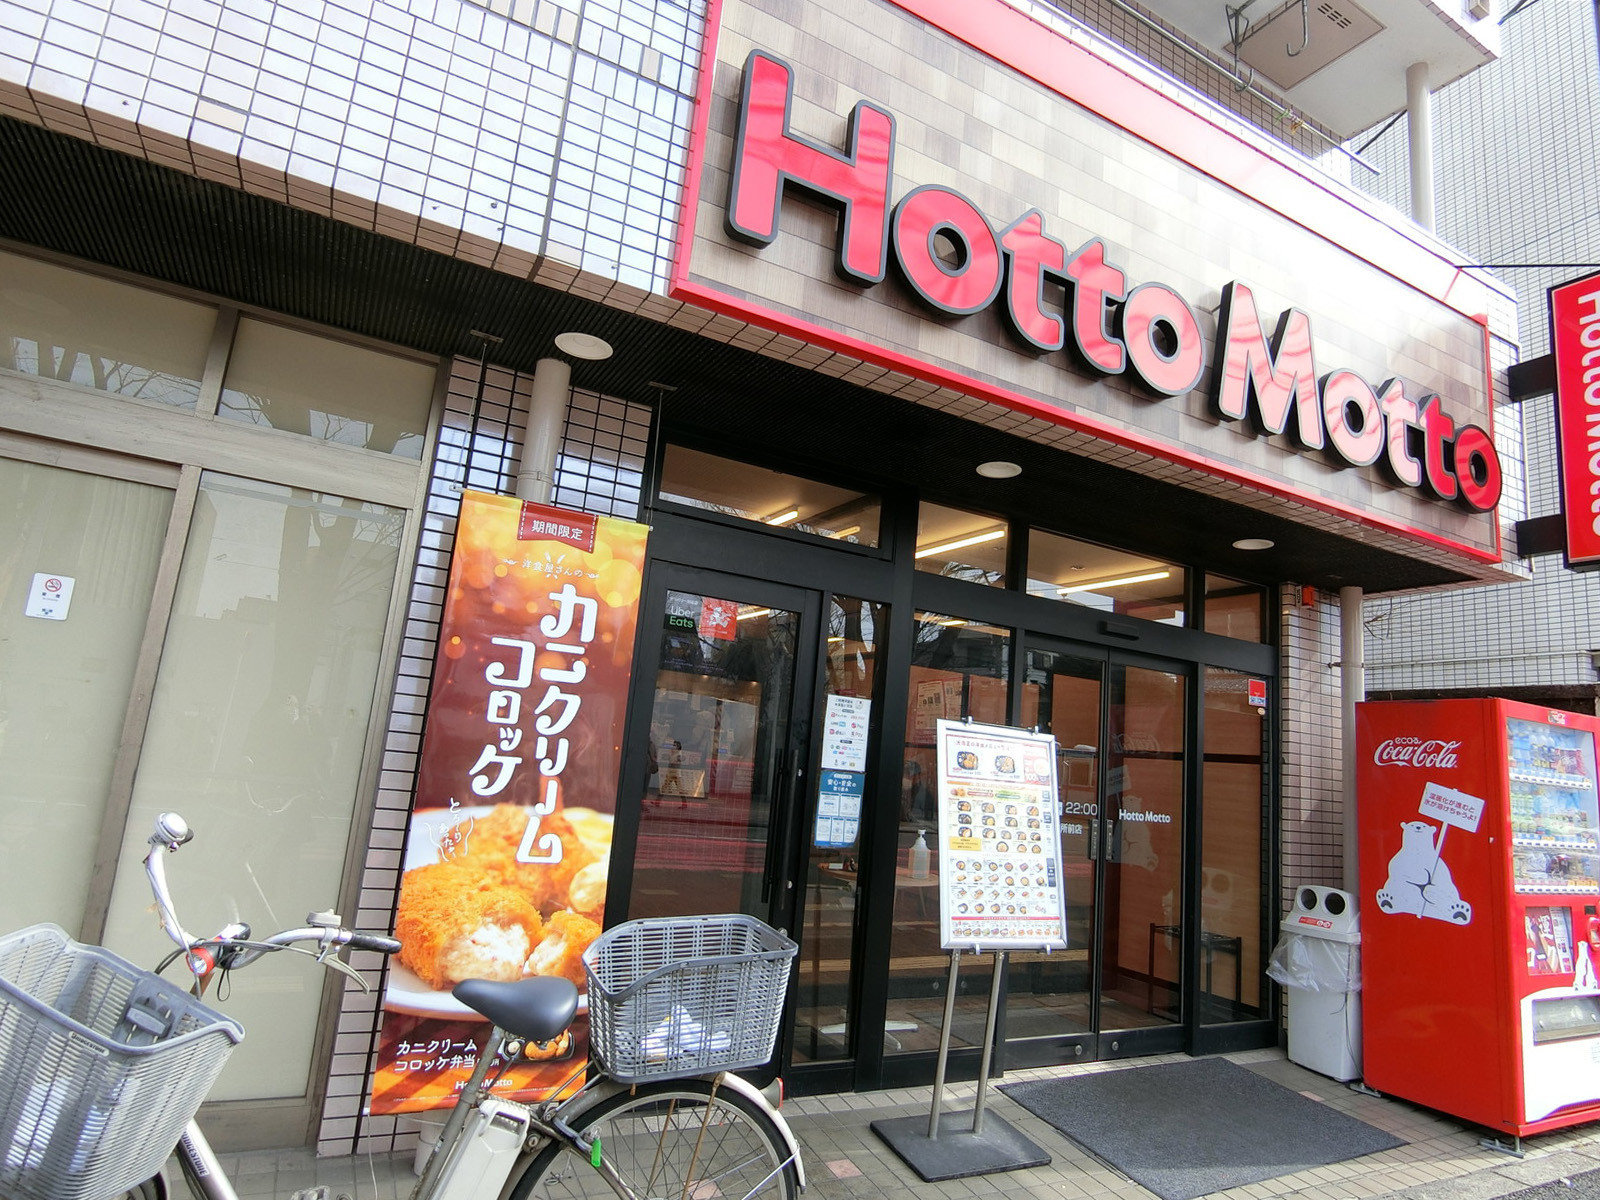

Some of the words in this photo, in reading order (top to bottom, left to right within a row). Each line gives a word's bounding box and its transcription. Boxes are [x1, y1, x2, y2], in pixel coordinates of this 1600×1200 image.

[724, 48, 1206, 398] Hotto
[1211, 279, 1503, 514] Motto
[531, 519, 584, 541] 期間限定
[521, 558, 584, 578] 洋食屋さんの
[670, 605, 695, 617] Uber
[669, 616, 694, 628] Eats
[469, 636, 536, 796] コロッケ
[516, 583, 599, 864] カニクリーム
[1374, 740, 1462, 768] Coca-Cola
[1065, 802, 1098, 816] 22:00
[1428, 792, 1475, 814] 温暖化が進むと
[1119, 808, 1144, 822] Hotto
[1145, 811, 1171, 823] Motto
[397, 1036, 478, 1056] カニクリーム
[393, 1053, 477, 1072] コロッケ弁当
